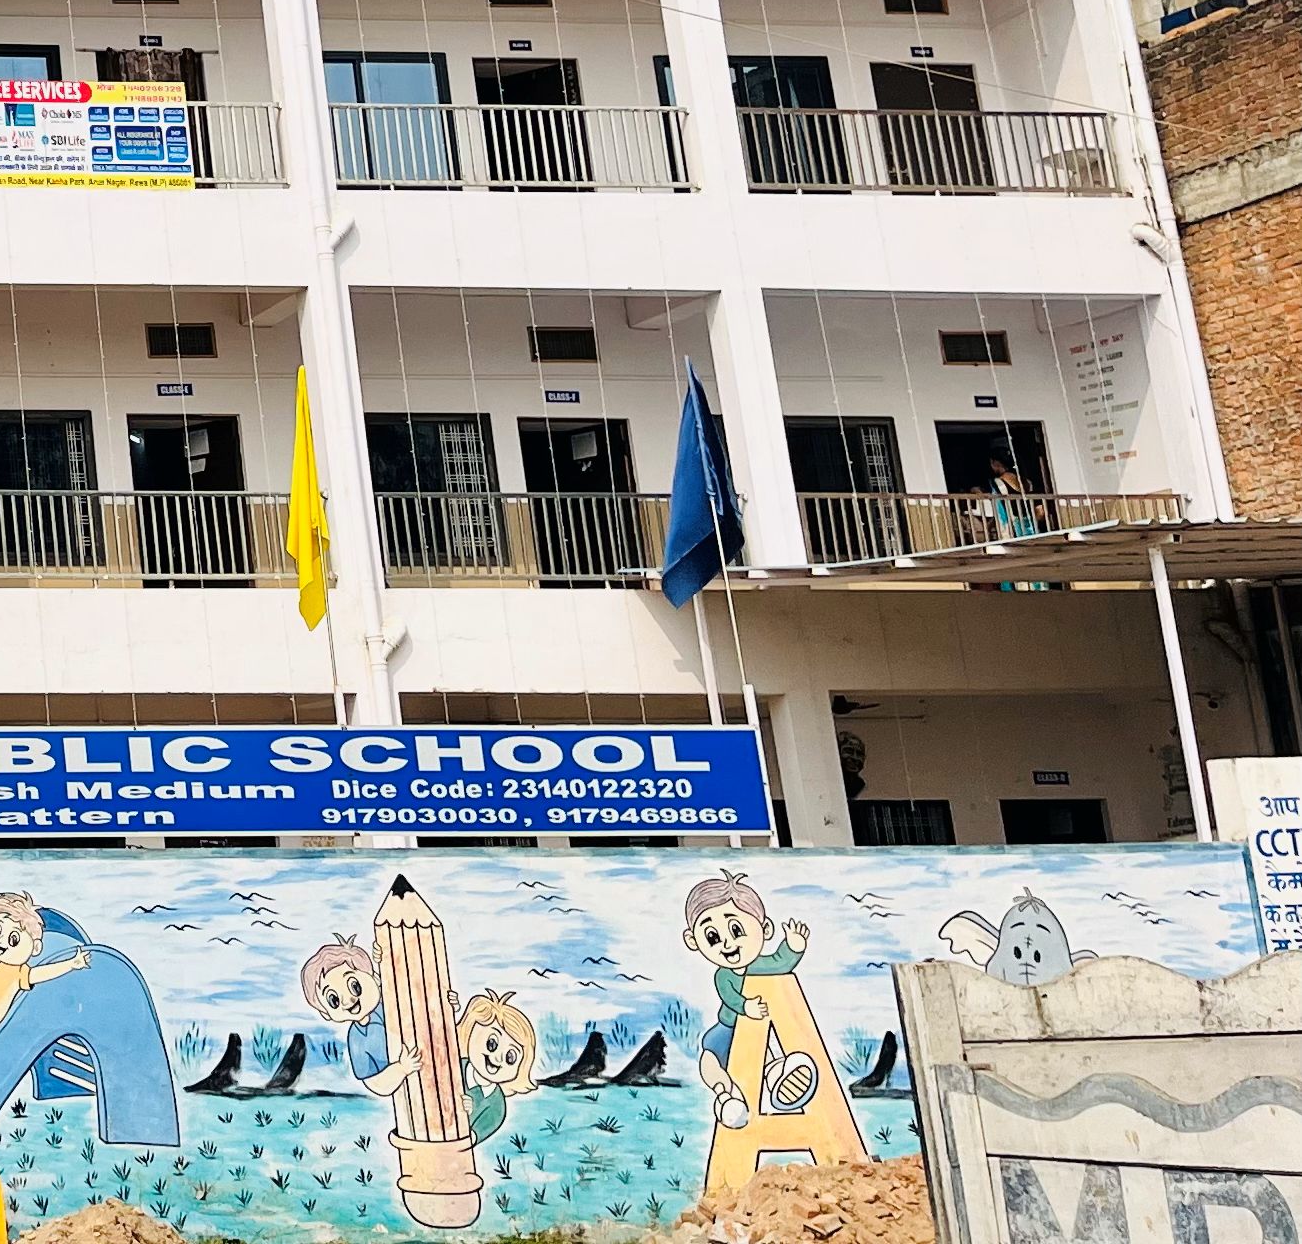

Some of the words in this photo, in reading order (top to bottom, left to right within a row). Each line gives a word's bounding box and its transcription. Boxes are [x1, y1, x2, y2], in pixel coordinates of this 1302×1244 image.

[13, 81, 82, 101] SERVICES
[50, 135, 67, 145] SBI
[68, 135, 86, 146] Life
[269, 735, 711, 773] SCHOOL
[66, 781, 295, 800] Medium
[331, 779, 397, 799] Dice
[410, 779, 494, 799] Code:
[502, 778, 693, 799] 23140122320
[321, 807, 532, 827] 9179030030,
[547, 807, 738, 825] 9179469866
[1255, 827, 1302, 858] CCT
